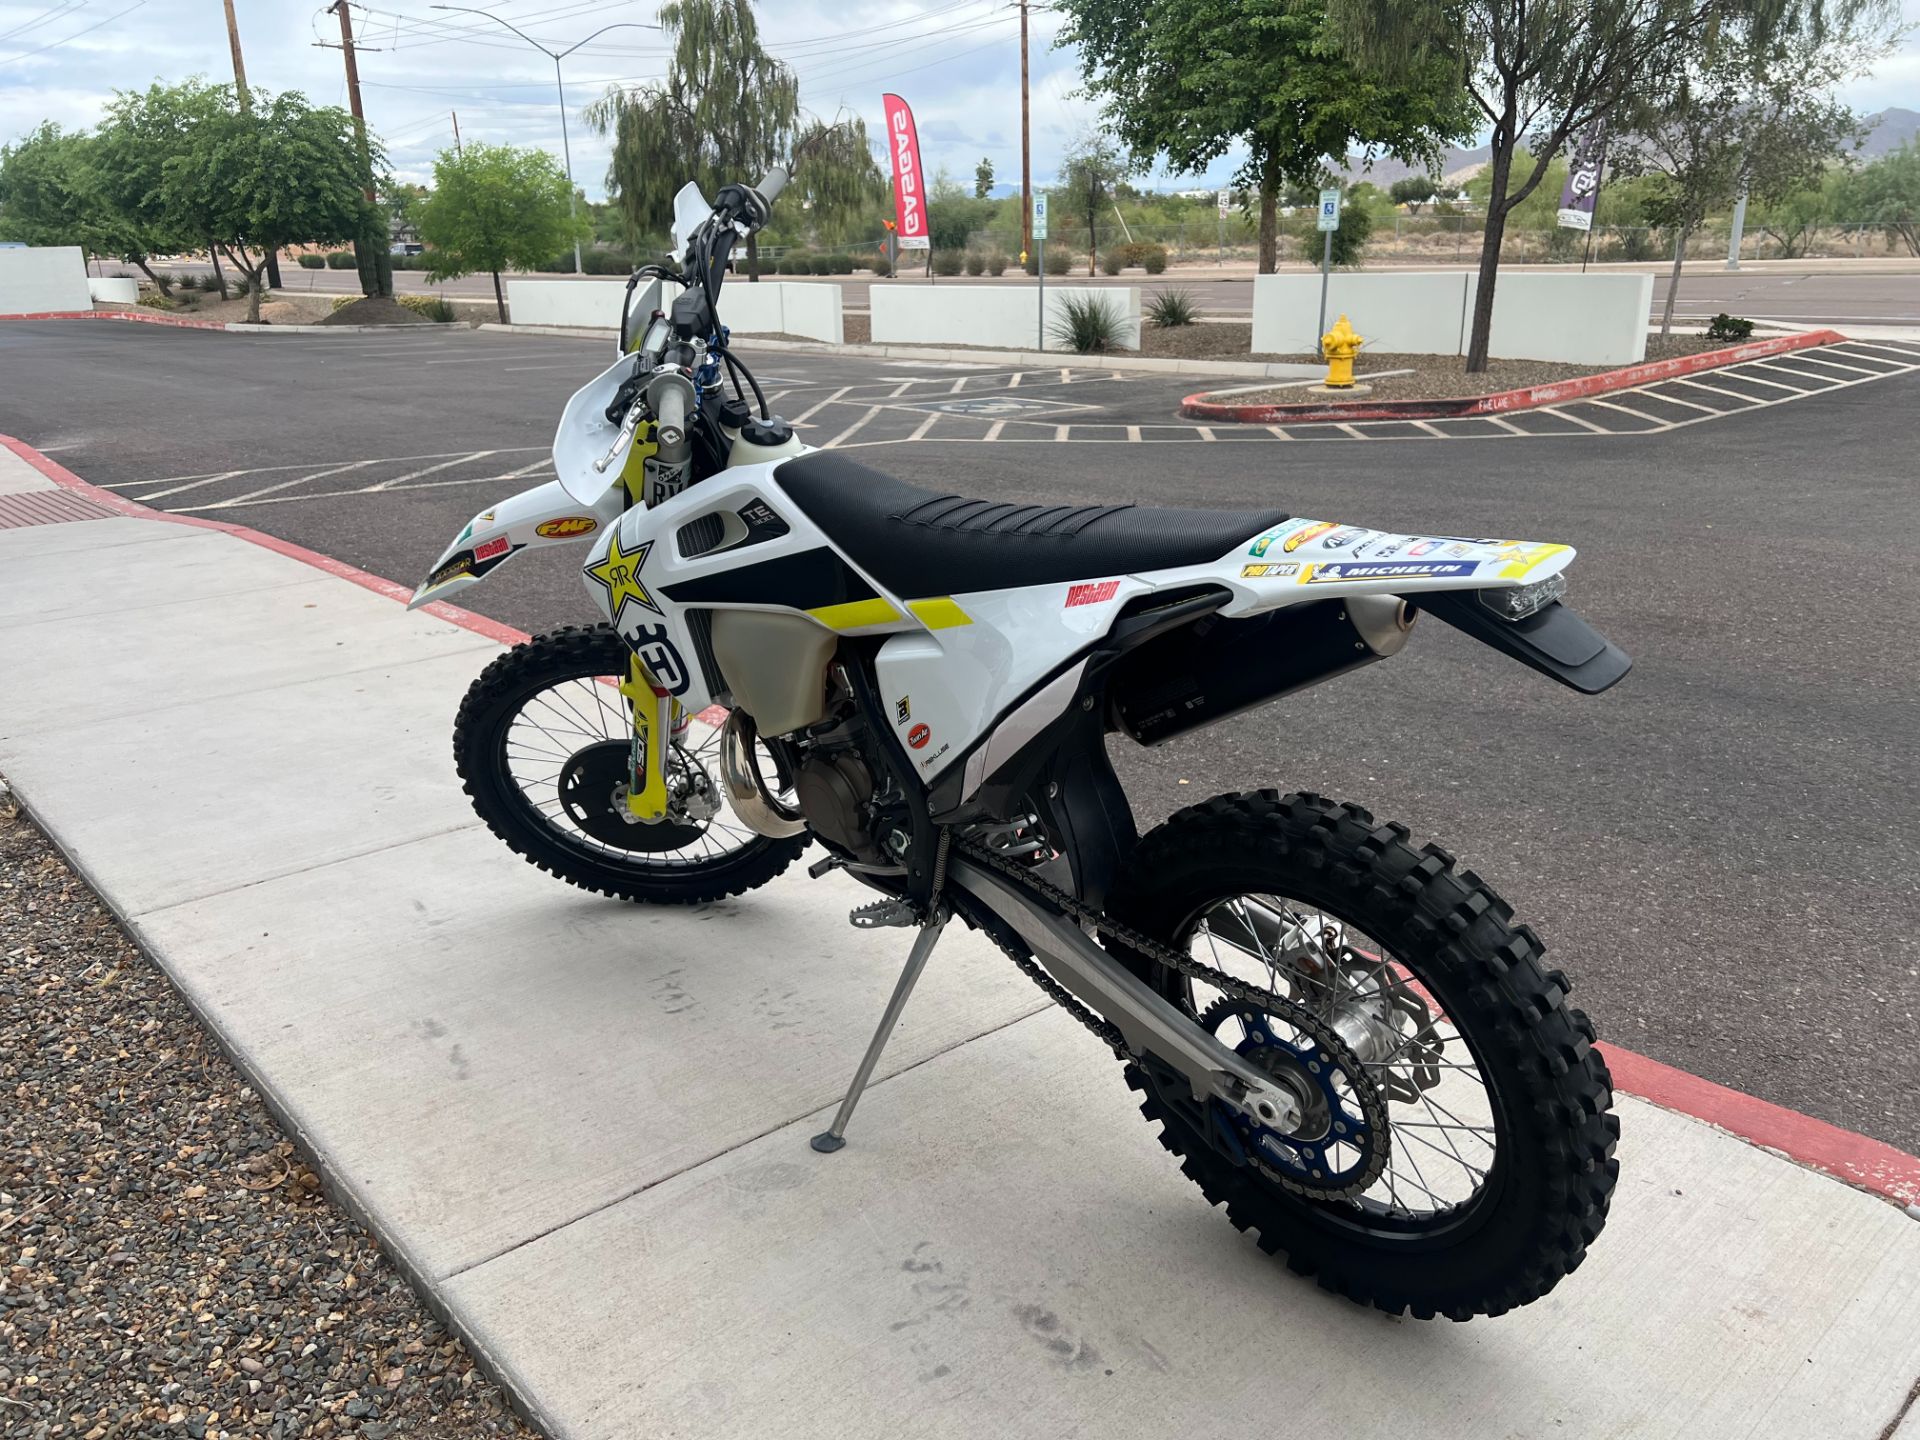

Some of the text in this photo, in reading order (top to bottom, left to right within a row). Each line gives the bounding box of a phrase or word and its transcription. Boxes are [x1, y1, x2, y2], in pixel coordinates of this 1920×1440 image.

[742, 505, 770, 520] TE
[538, 518, 597, 537] FMF
[1345, 563, 1462, 577] MICHELIN
